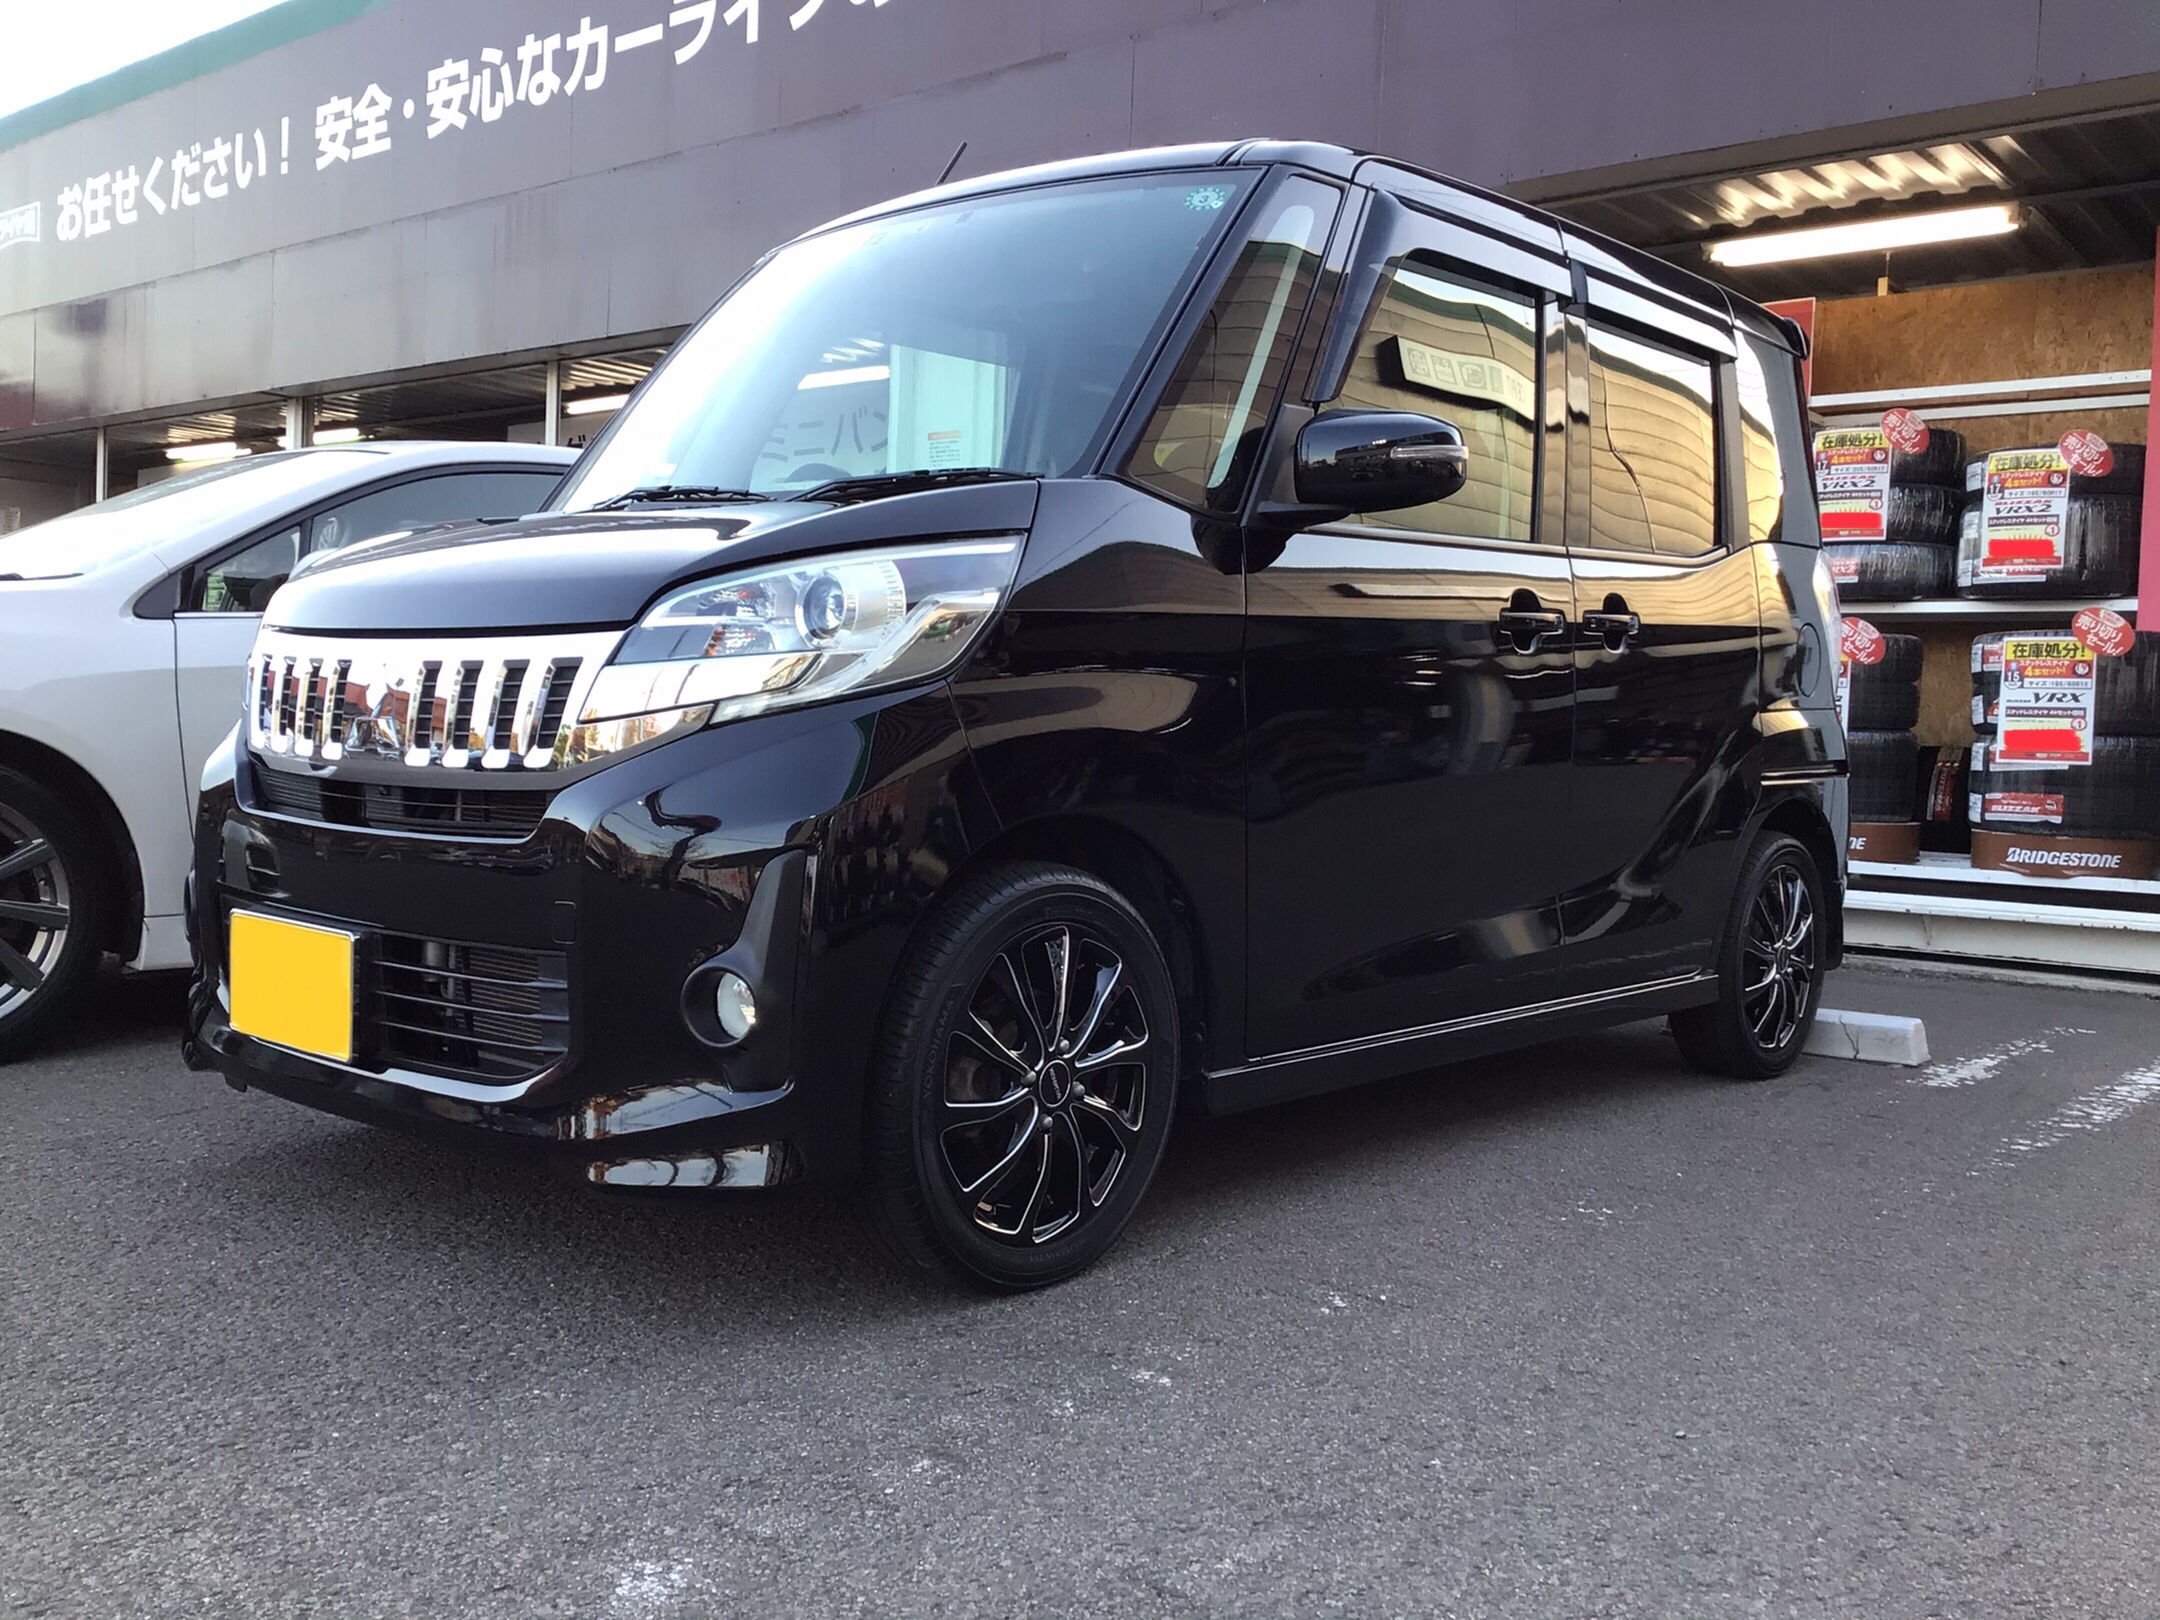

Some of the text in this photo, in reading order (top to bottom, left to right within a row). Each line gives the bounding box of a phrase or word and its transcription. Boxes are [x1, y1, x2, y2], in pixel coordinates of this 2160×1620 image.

[1817, 461, 1828, 471] 17
[1822, 479, 1876, 490] VRX2
[1989, 484, 2002, 494] 17
[1995, 504, 2053, 515] VRX2
[2012, 643, 2086, 659] 在庫処分!
[2006, 671, 2020, 682] 15
[2033, 692, 2086, 704] VRX
[1991, 804, 2041, 813] BLIZZAK
[2006, 847, 2122, 869] BRIDGESTONE
[923, 1000, 954, 1099] YOKOHAMA
